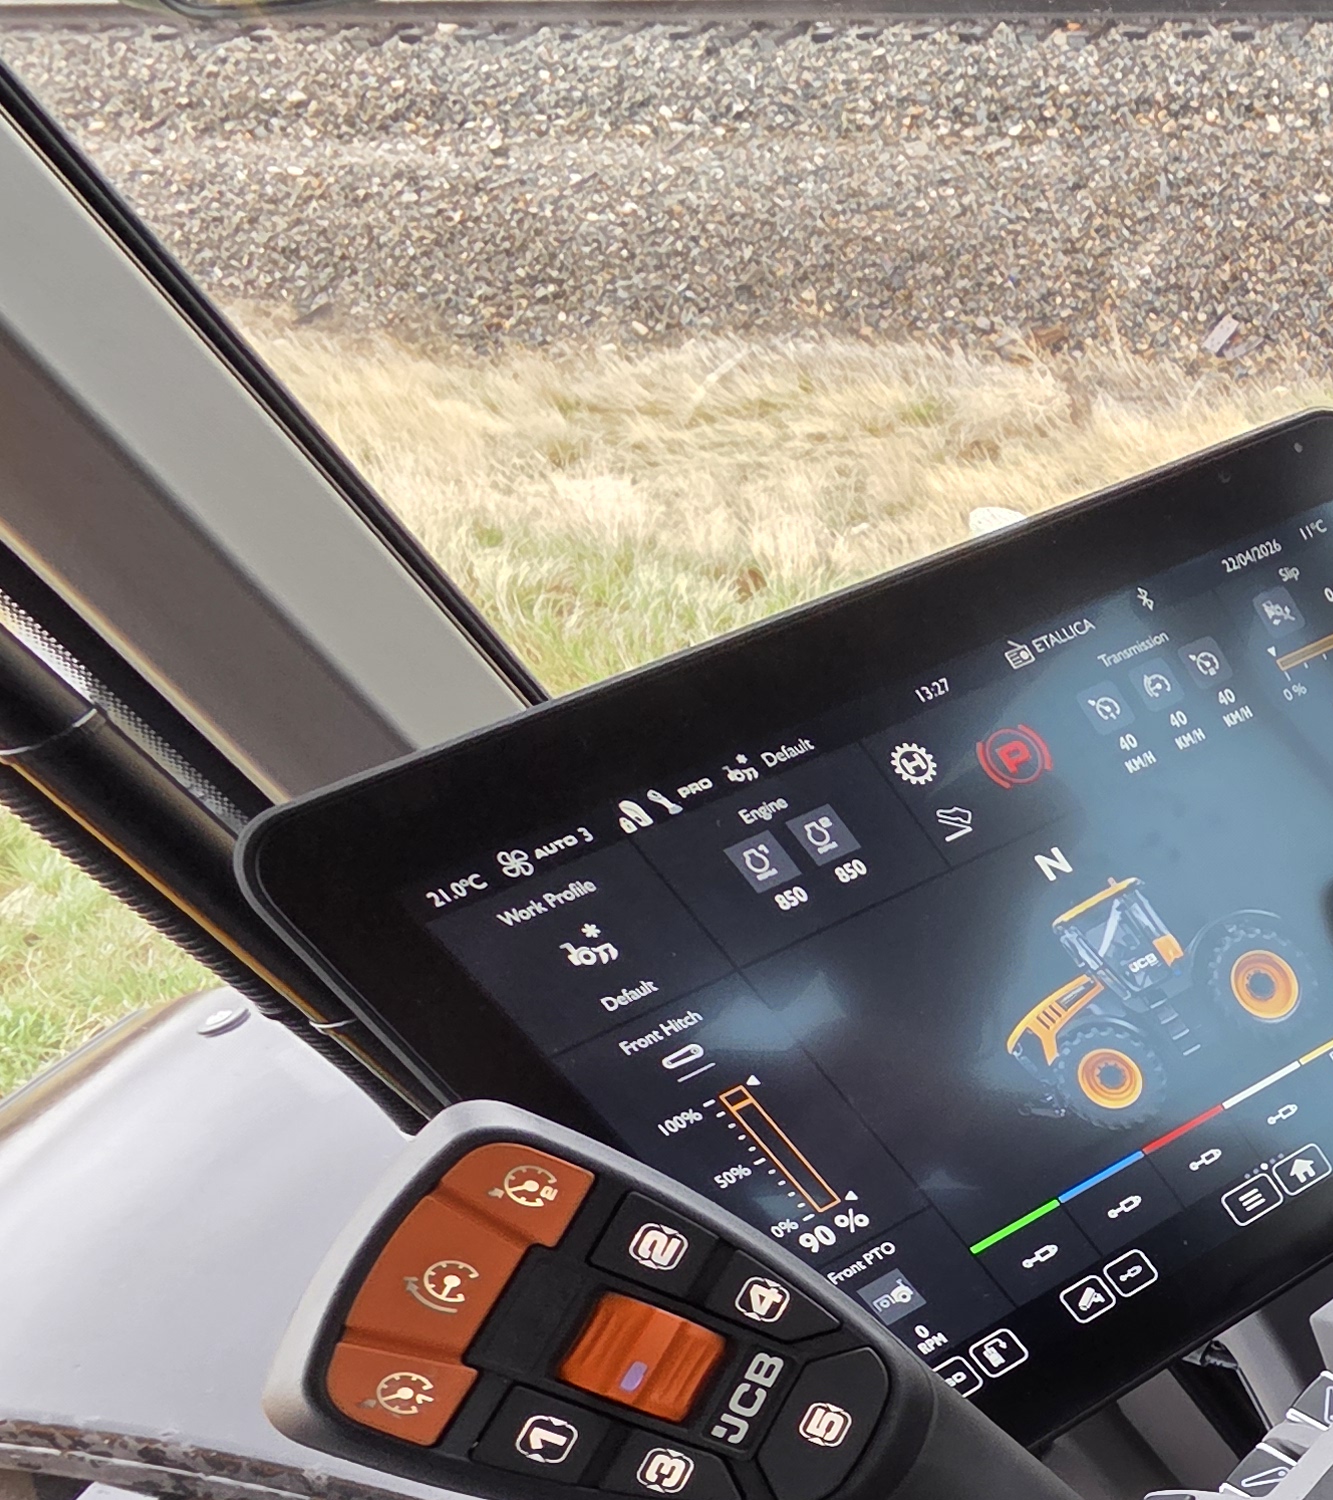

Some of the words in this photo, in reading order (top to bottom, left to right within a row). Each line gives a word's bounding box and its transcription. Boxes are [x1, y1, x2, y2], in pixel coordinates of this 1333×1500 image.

[1221, 538, 1282, 573] 22/04/2026
[1278, 567, 1300, 582] Slip
[1032, 618, 1096, 653] ETALLICA
[1097, 632, 1170, 668] Transmission
[915, 678, 951, 703] 13:27
[1217, 688, 1236, 706] 40
[1169, 710, 1188, 728] 40
[1222, 705, 1254, 728] KM/H
[761, 737, 815, 769] Default
[1119, 733, 1138, 751] 40
[1174, 728, 1206, 750] KM/H
[1124, 750, 1157, 774] KM/H
[677, 777, 713, 799] PRO
[738, 798, 788, 824] Engine
[534, 833, 578, 862] AUTO
[834, 859, 867, 883] 850
[1034, 846, 1073, 881] N
[426, 873, 488, 909] 21.0°C
[496, 899, 548, 929] Work
[545, 878, 597, 908] Profile
[774, 886, 808, 911] 850
[600, 979, 659, 1014] Default
[619, 1028, 662, 1057] Front
[658, 1011, 704, 1041] Hitch
[657, 1108, 703, 1137] 100%
[713, 1164, 752, 1189] 50%
[770, 1218, 799, 1239] 0%
[646, 1229, 680, 1266] 2
[826, 1260, 867, 1285] Front
[862, 1241, 896, 1266] PTO
[749, 1282, 783, 1321] 4
[914, 1325, 929, 1339] 0
[917, 1332, 949, 1355] RPM
[711, 1352, 785, 1445] JCB
[811, 1410, 842, 1441] 5
[647, 1456, 686, 1488] 3
